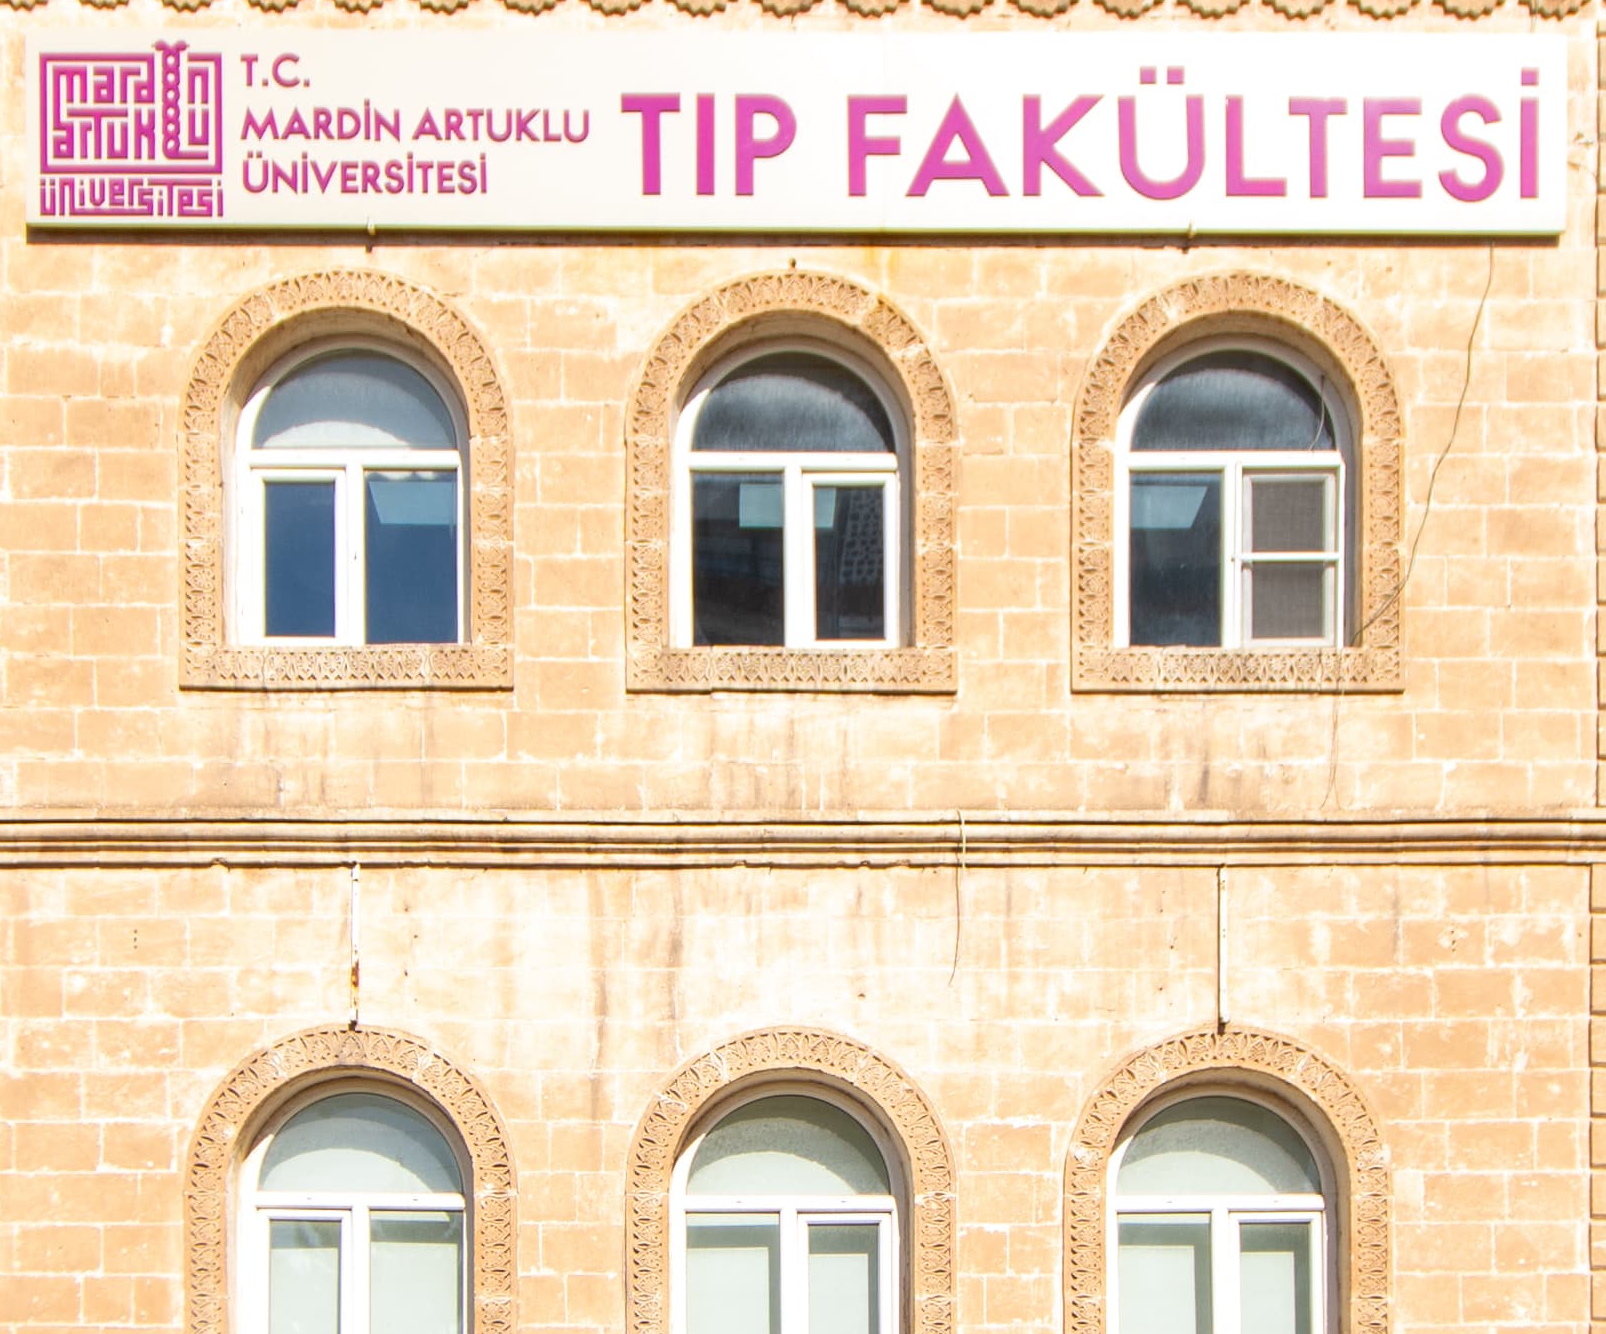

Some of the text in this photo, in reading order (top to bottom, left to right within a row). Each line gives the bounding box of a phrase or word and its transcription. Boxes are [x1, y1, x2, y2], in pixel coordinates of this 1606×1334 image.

[240, 53, 311, 88] T.C.
[240, 98, 590, 144] MARDİN ARTUKLU
[620, 66, 1540, 202] TIP FAKÜLTESİ
[242, 151, 488, 196] ÜNİVERSİTESİ
